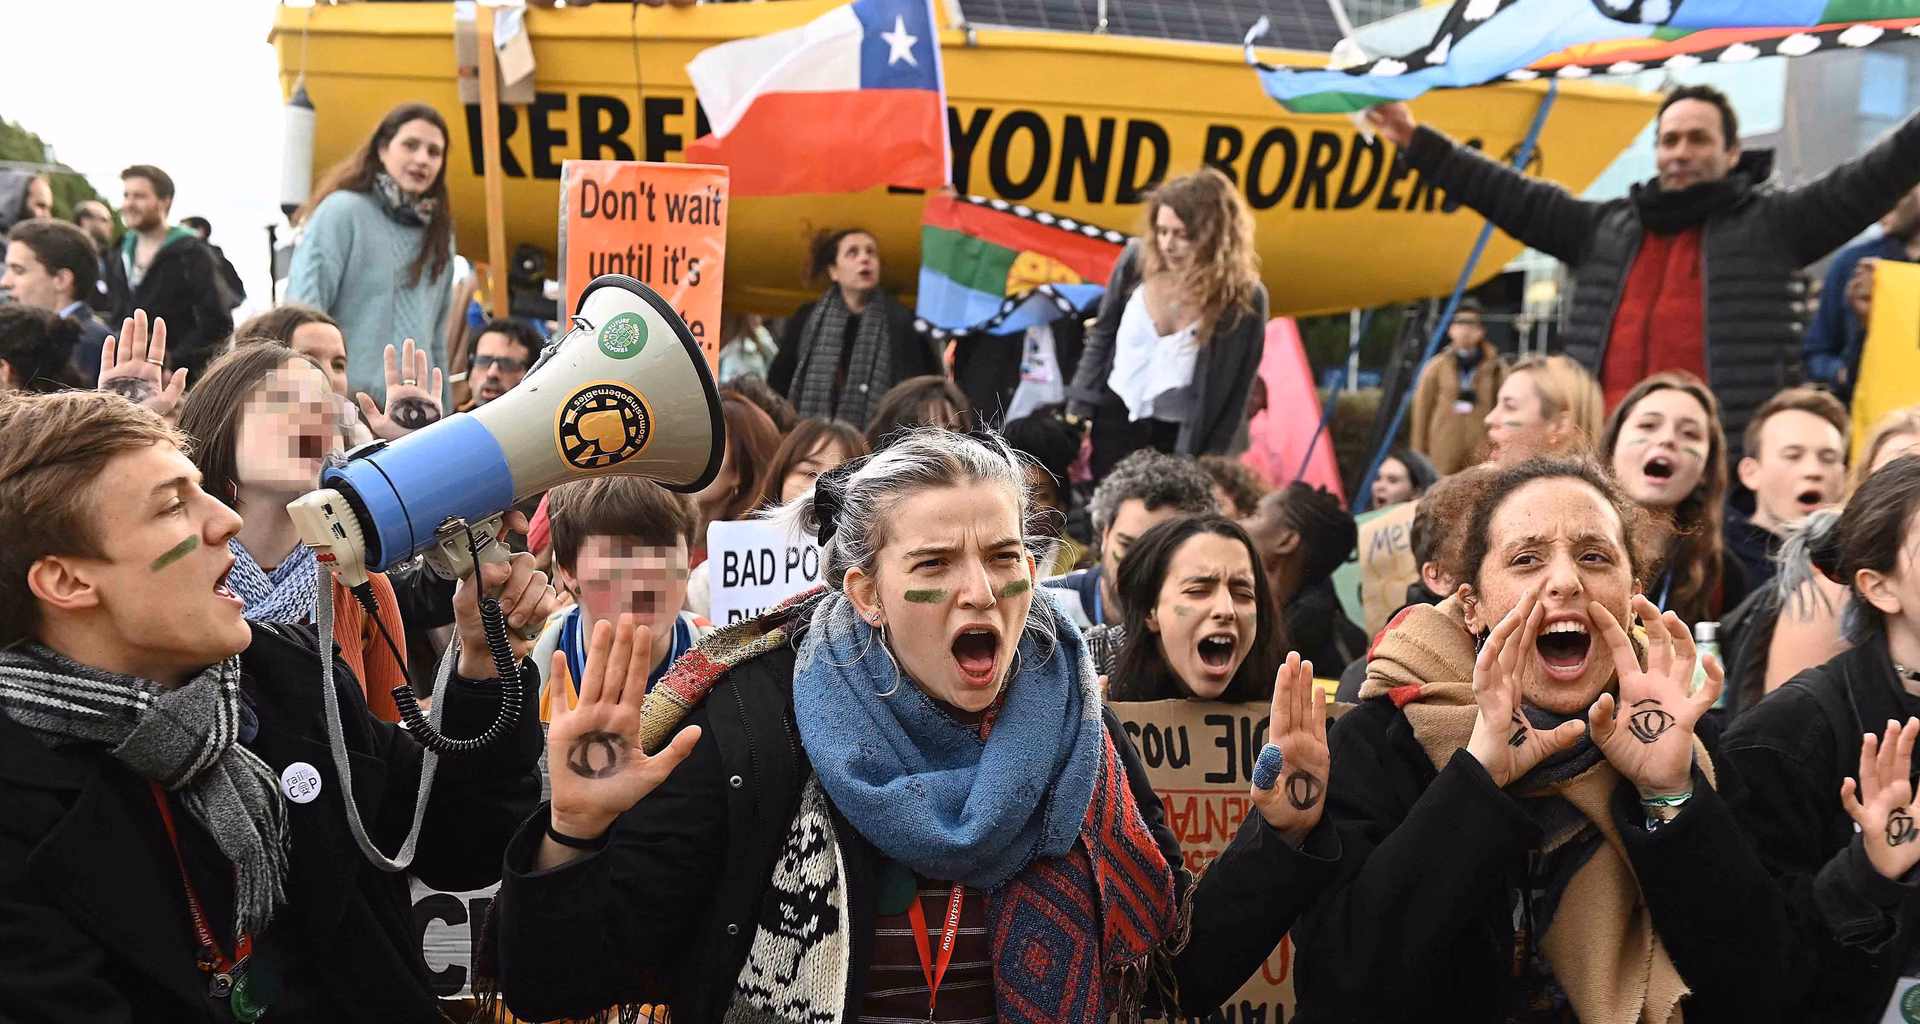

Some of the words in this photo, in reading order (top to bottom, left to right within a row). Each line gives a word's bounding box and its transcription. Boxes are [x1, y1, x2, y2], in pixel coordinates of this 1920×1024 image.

[887, 106, 1170, 204] YOND
[580, 179, 656, 222] Don't
[665, 185, 721, 226] wait
[589, 243, 652, 283] until
[663, 245, 700, 287] it's
[722, 549, 776, 588] BAD
[785, 544, 820, 584] PO
[286, 771, 304, 787] rail
[942, 929, 955, 952] Now
